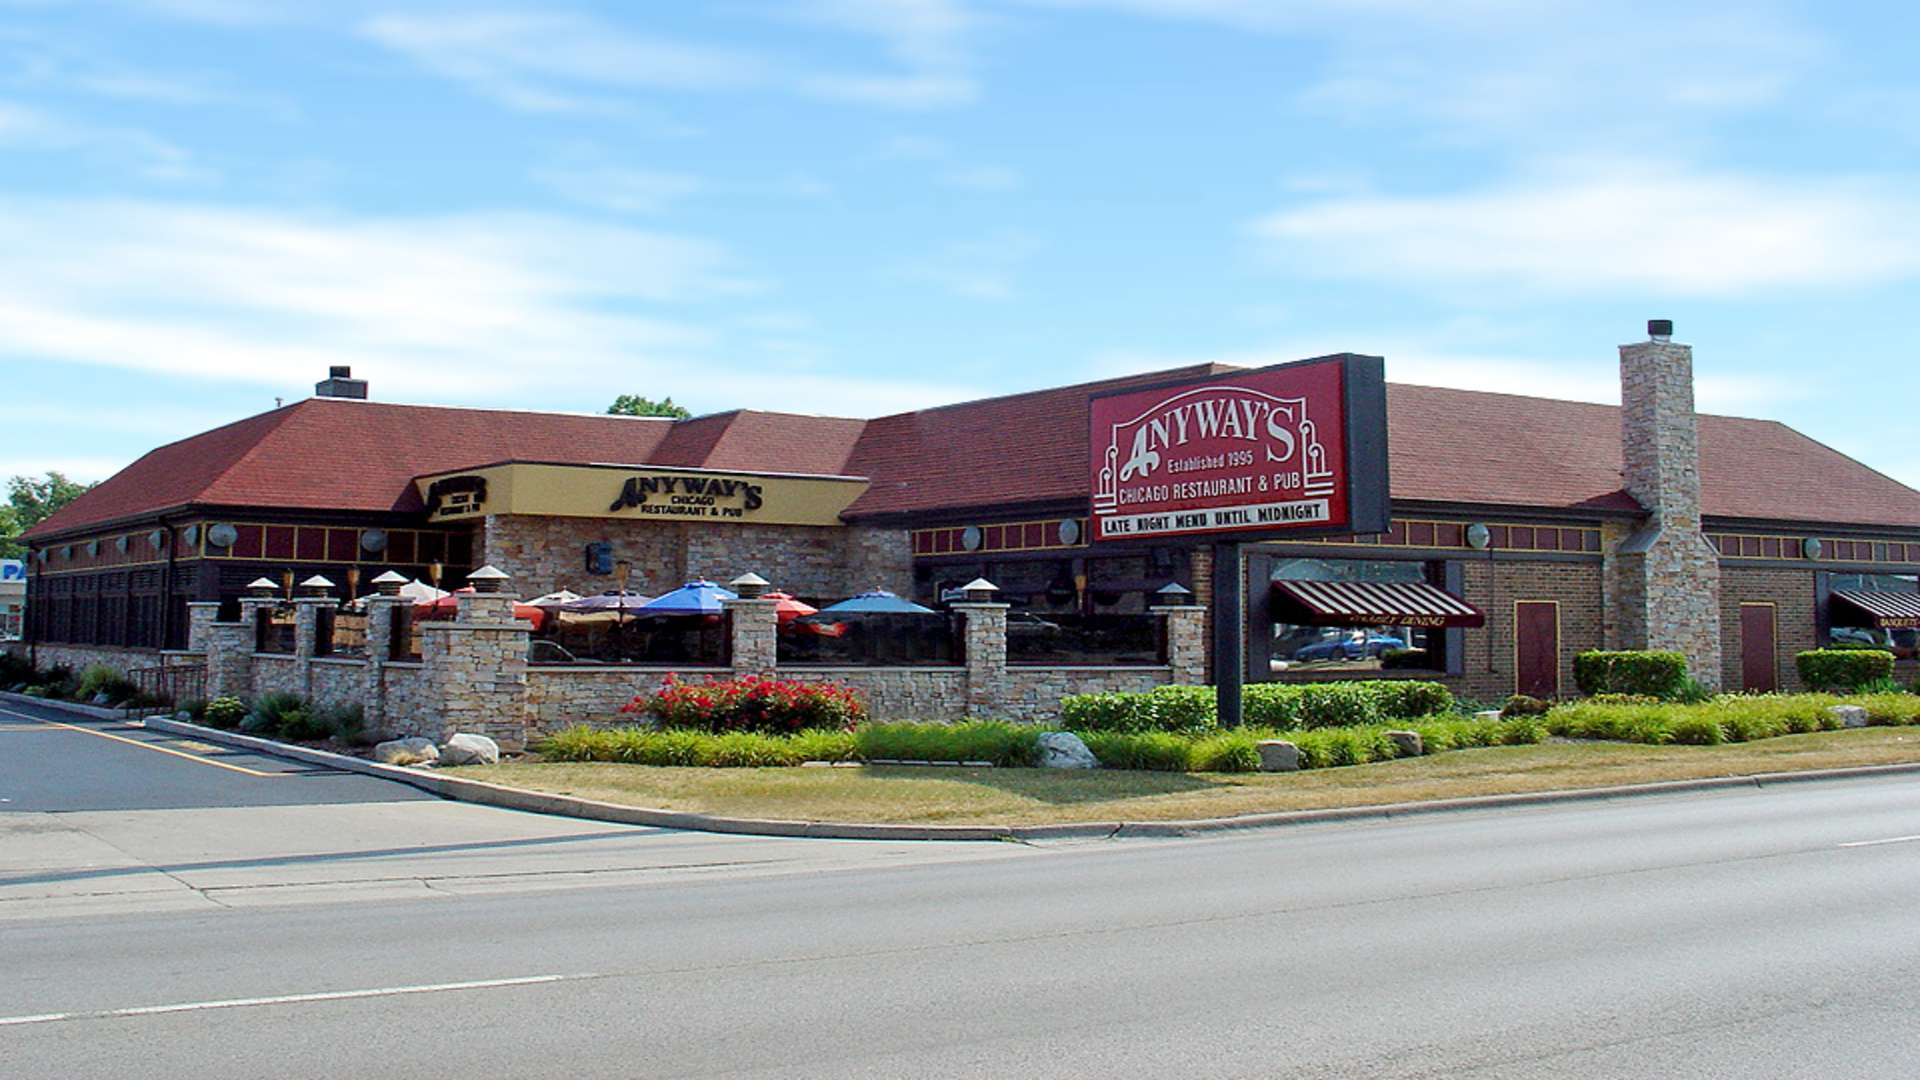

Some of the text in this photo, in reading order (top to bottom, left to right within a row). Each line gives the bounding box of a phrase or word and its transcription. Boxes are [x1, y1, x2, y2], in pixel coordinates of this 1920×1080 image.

[1120, 398, 1295, 482] ANYWAY'S
[1168, 451, 1254, 474] Established 1995
[609, 477, 763, 512] ANYWAY'S
[671, 495, 715, 506] CHICAGO
[1119, 472, 1301, 504] CHICAGO RESTAURANT & PUB
[641, 504, 743, 518] RESTAURANT & PUB
[1104, 504, 1321, 534] LATE NIGHT MENU UNTIL MIDNIGHT
